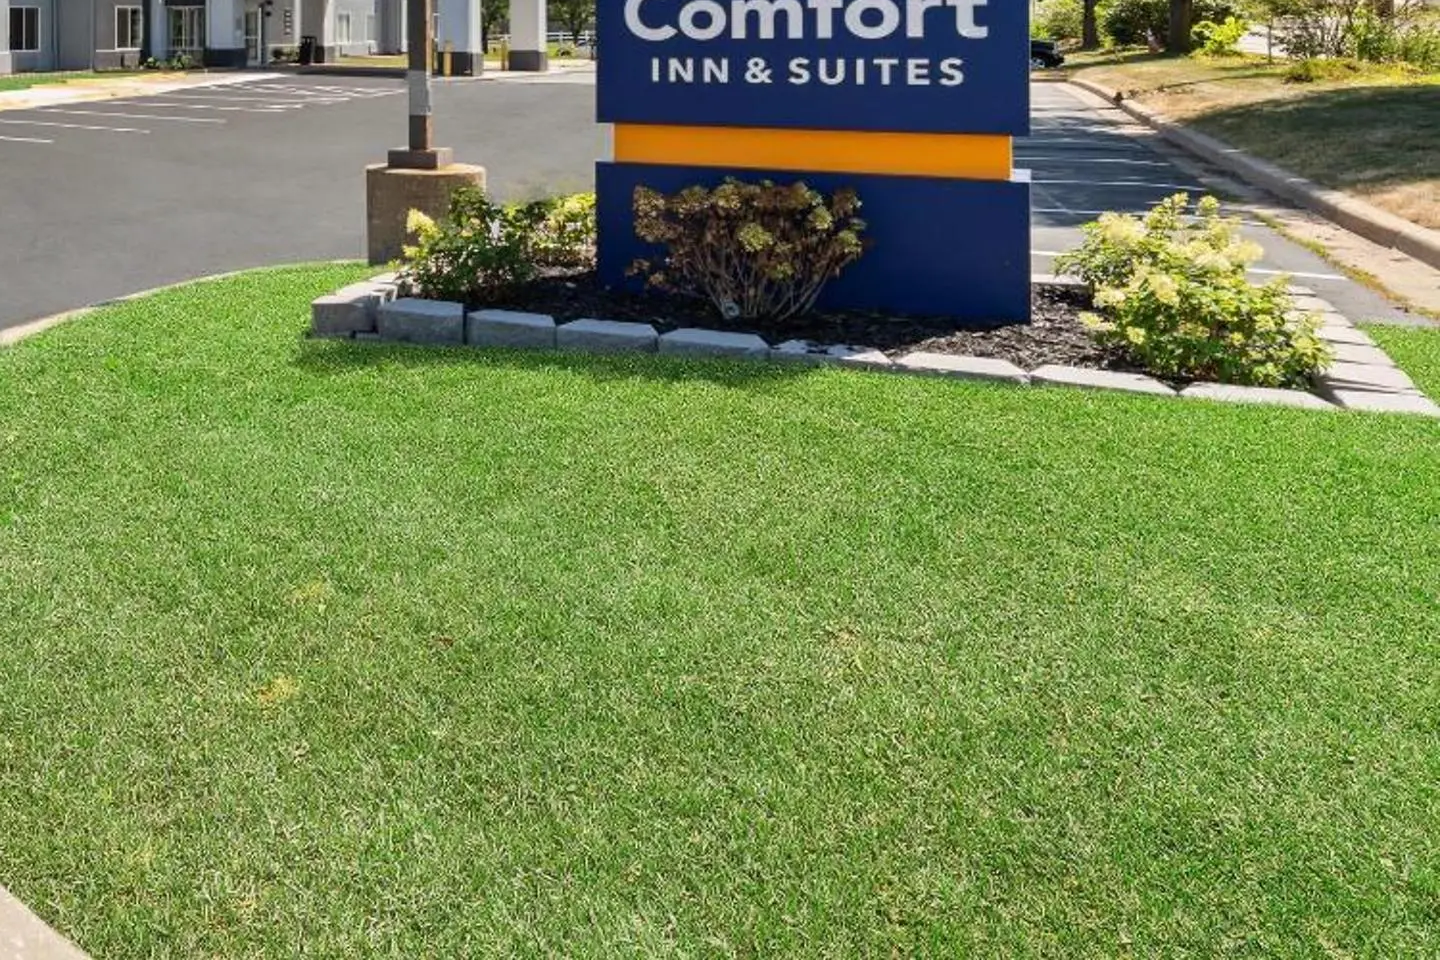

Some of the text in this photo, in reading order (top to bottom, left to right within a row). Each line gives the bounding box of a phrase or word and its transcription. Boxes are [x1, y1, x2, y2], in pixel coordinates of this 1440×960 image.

[652, 57, 965, 86] INN & SUITES
